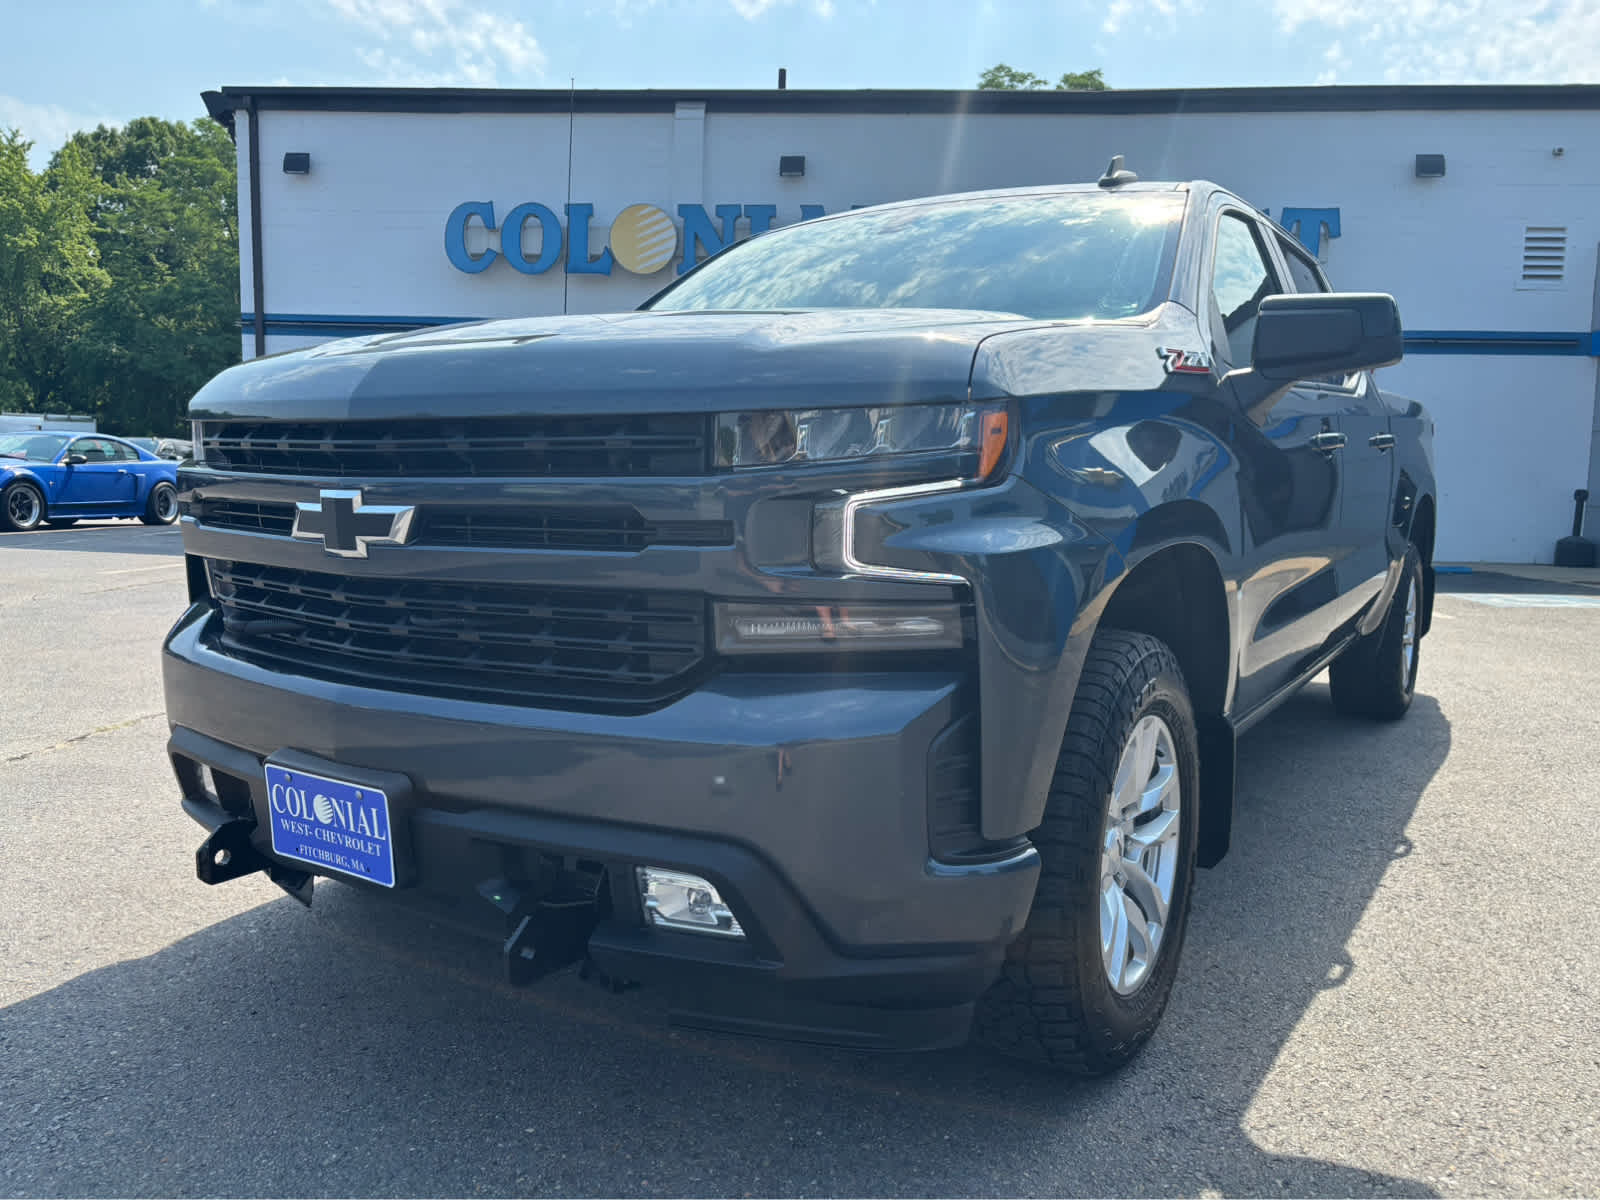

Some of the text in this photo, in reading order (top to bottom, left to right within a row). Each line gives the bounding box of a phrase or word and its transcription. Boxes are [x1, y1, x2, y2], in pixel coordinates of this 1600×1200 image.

[1155, 346, 1210, 374] Z71
[272, 783, 386, 841] COLONIAL
[299, 844, 350, 867] FITCHBURG,
[314, 827, 382, 857] CHEVROLET
